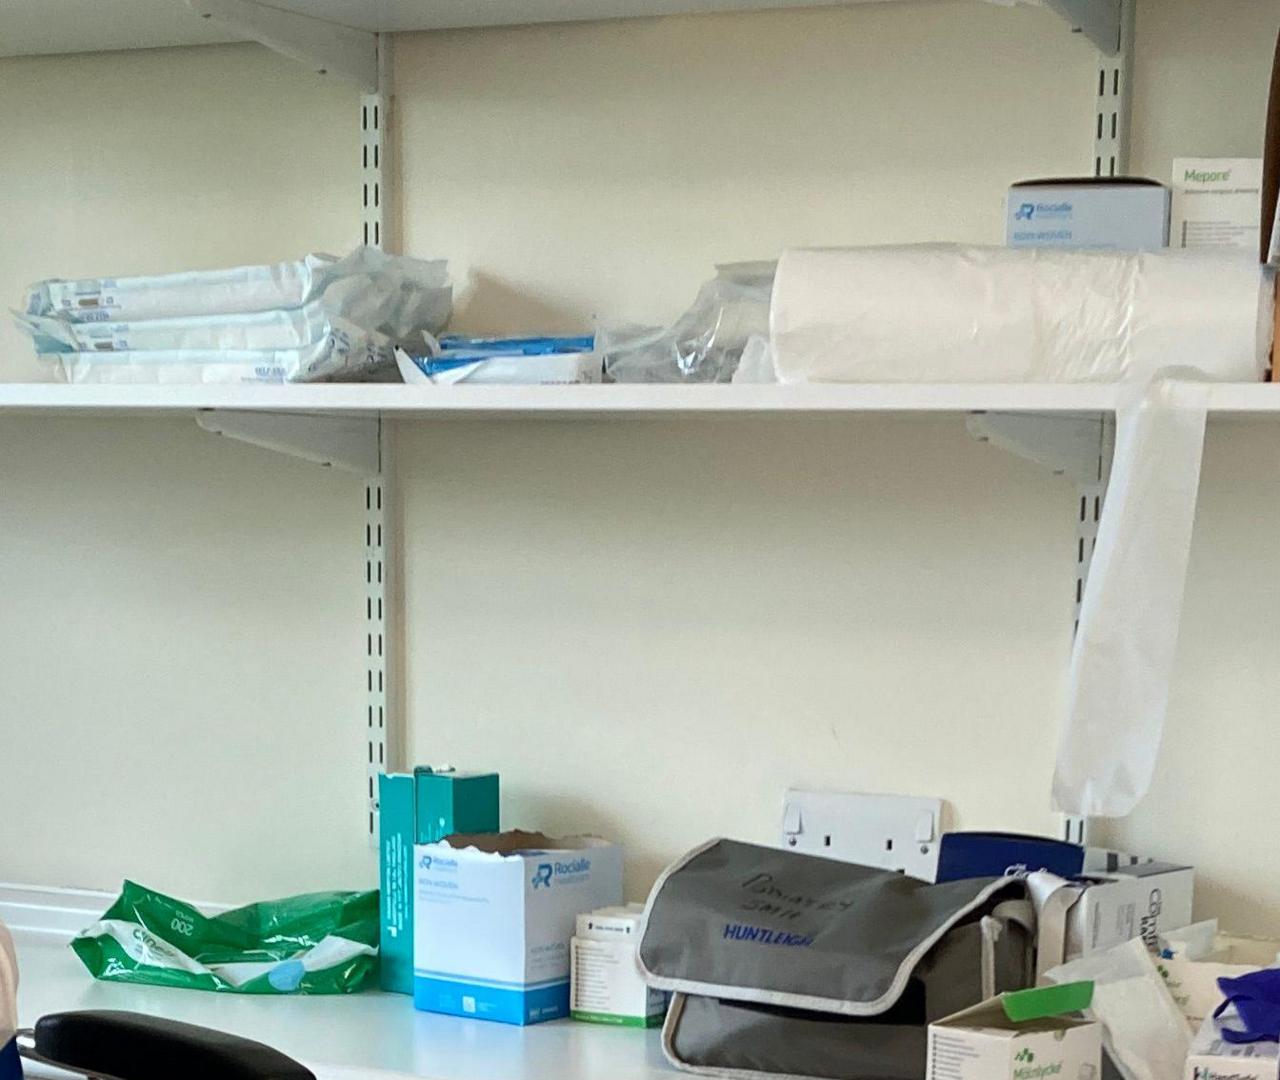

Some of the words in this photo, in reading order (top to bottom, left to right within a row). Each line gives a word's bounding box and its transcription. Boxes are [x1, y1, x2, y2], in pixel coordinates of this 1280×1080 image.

[554, 857, 592, 876] Rocialle
[170, 918, 194, 937] 200
[723, 924, 814, 947] HUNTLEIGH
